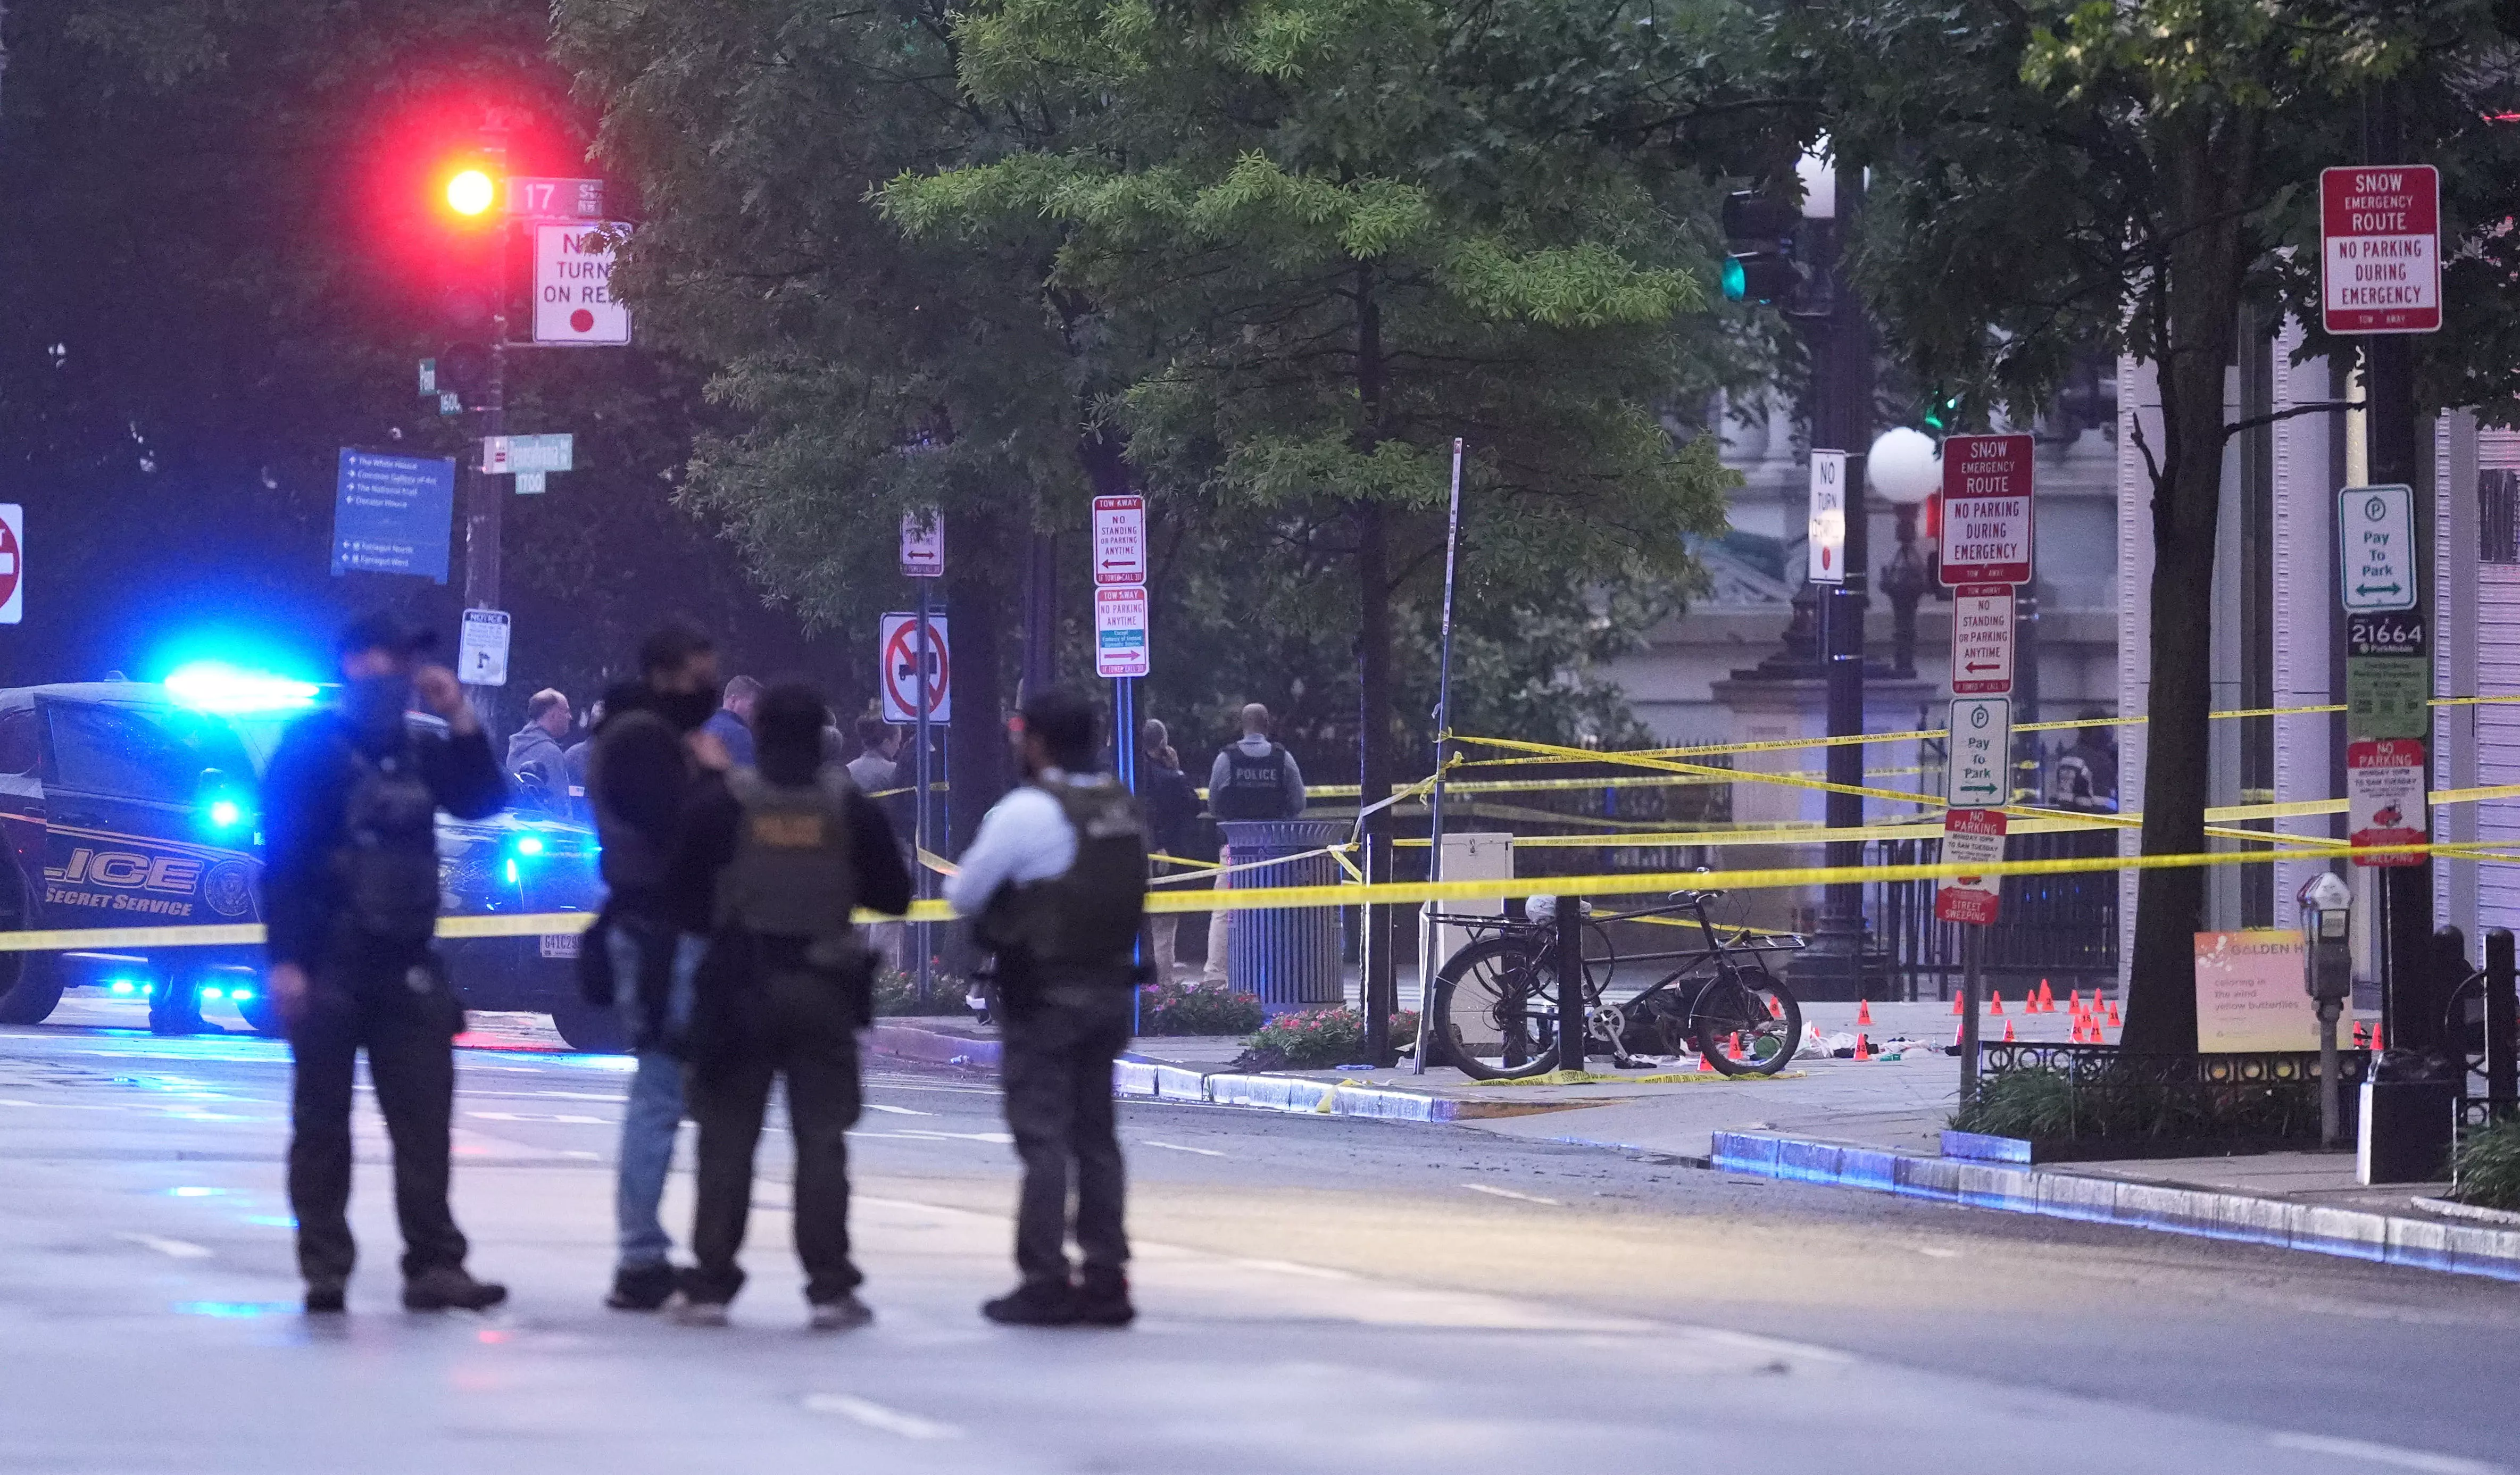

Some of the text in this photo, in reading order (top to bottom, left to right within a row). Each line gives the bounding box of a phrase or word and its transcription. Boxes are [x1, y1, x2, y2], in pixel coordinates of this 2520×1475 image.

[2356, 173, 2402, 193] SNOW
[525, 184, 555, 210] 17
[2345, 196, 2414, 210] EMERGENCY
[2352, 212, 2407, 231] ROUTE
[2340, 239, 2421, 259] NO PARKING
[557, 262, 609, 278] TURN
[2356, 263, 2407, 281] DURING
[544, 286, 569, 303] ON
[2342, 286, 2421, 305] EMERGENCY
[2386, 314, 2406, 323] AWAY
[1970, 441, 2007, 458] SNOW
[1820, 462, 1835, 485] NO
[1961, 461, 2015, 473] EMERGENCY
[1967, 477, 2009, 493] ROUTE
[1955, 501, 2019, 519] NO PARKING
[1102, 527, 1137, 535] STANDING
[1967, 522, 2006, 539] DURING
[2364, 531, 2390, 545] Pay
[1955, 543, 2017, 560] EMERGENCY
[2369, 549, 2385, 562] To
[2363, 564, 2393, 577] Park
[1104, 590, 1138, 600] TOW AWAY
[1101, 604, 1142, 614] NO PARKING
[1978, 600, 1990, 611] NO
[1108, 616, 1136, 626] ANYTIME
[1963, 615, 2004, 627] STANDING
[1959, 631, 2008, 643] OR PARKING
[2352, 623, 2422, 643] 21664
[1965, 647, 2000, 659] ANYTIME
[1969, 737, 1989, 751] Pay
[2377, 741, 2393, 754] NO
[1973, 754, 1985, 764] To
[2359, 753, 2412, 767] PARKING
[1236, 768, 1277, 780] POLICE
[1965, 768, 1991, 779] Park
[1970, 812, 1984, 822] NO
[1955, 821, 1997, 835] PARKING
[46, 888, 193, 916] SECRET SERVICE
[1952, 900, 1981, 910] STREET
[1945, 908, 1985, 921] SWEEPING
[1561, 1071, 1578, 1082] CROSS
